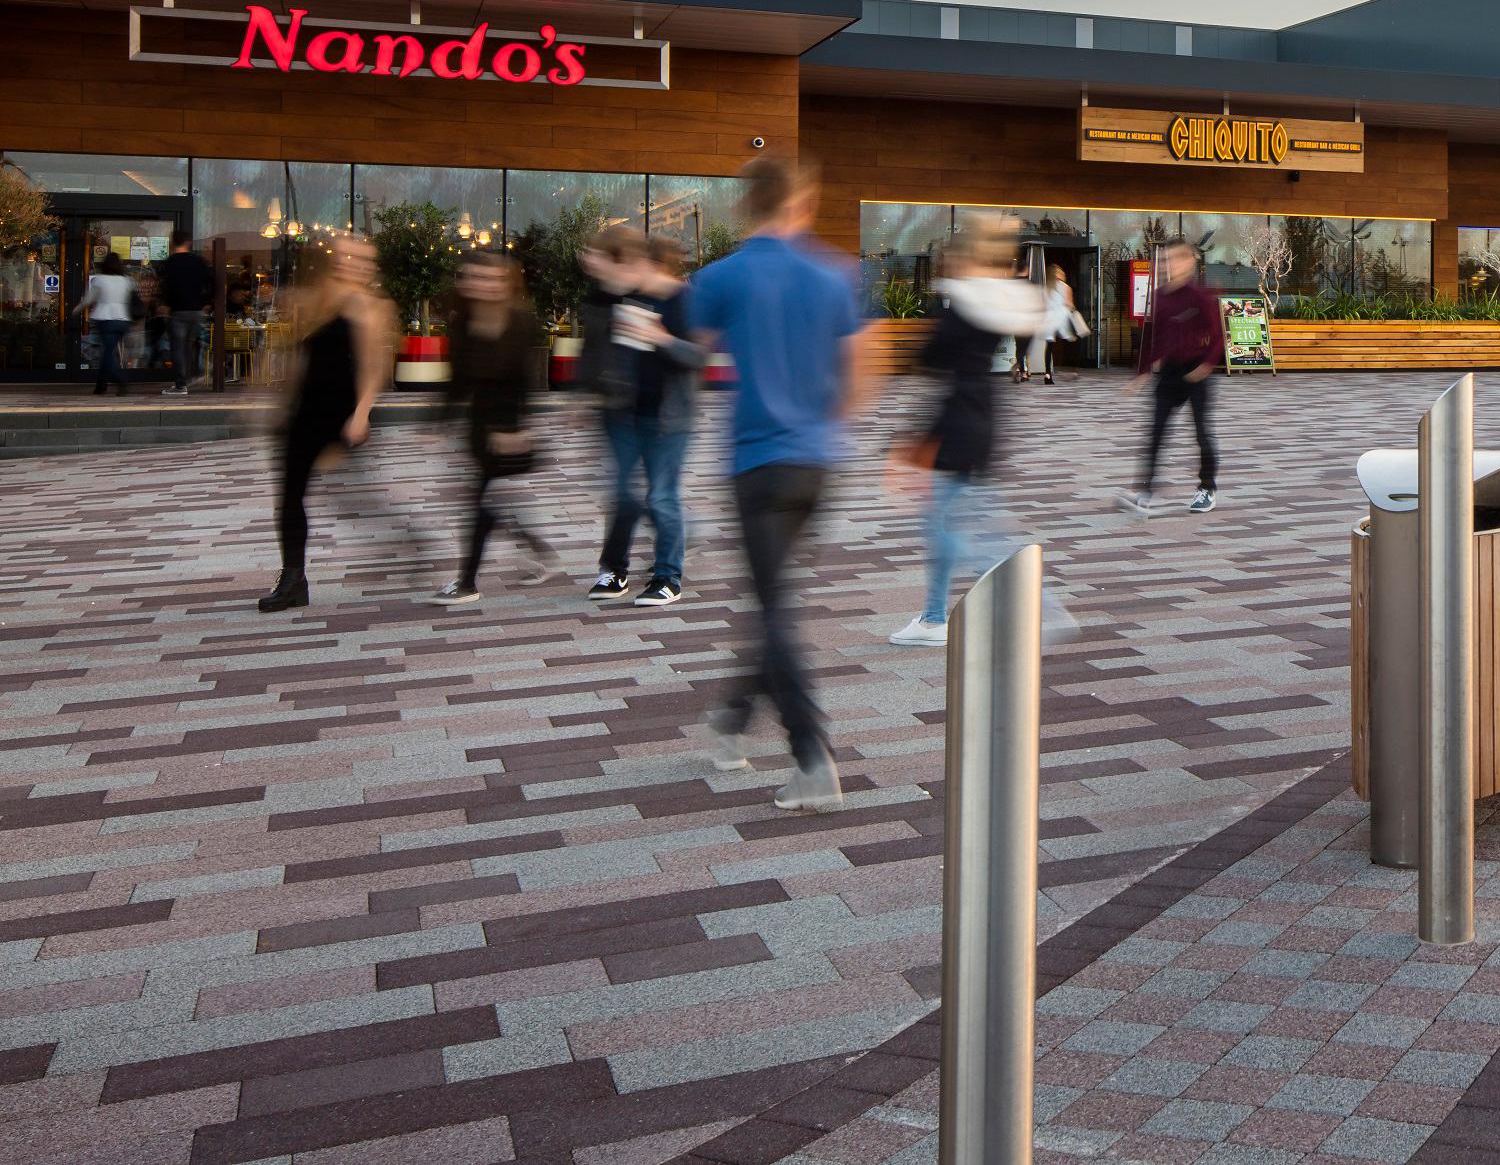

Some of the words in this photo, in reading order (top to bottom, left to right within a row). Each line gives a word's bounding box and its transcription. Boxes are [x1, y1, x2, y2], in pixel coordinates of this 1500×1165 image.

[230, 5, 586, 85] Nando's
[1171, 117, 1288, 163] CHIQUITO
[1237, 329, 1256, 340] £10
